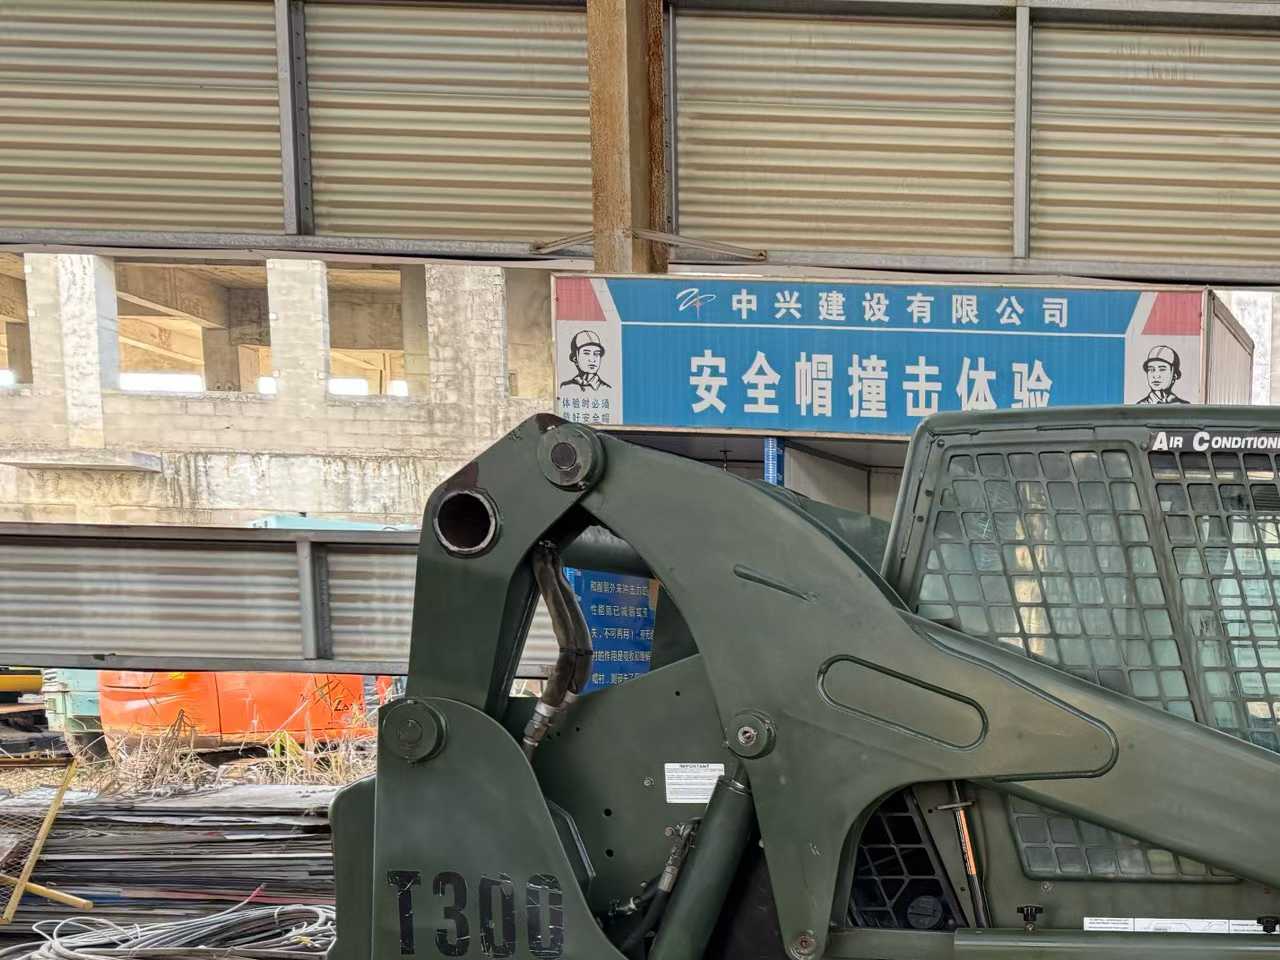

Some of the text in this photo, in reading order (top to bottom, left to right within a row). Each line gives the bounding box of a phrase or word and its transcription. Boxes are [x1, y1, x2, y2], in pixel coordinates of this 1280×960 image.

[731, 288, 1069, 328] 中兴建设有限公司
[689, 349, 1054, 419] 安全帽撞击体验
[1152, 431, 1183, 451] AIR
[387, 870, 564, 960] T300
